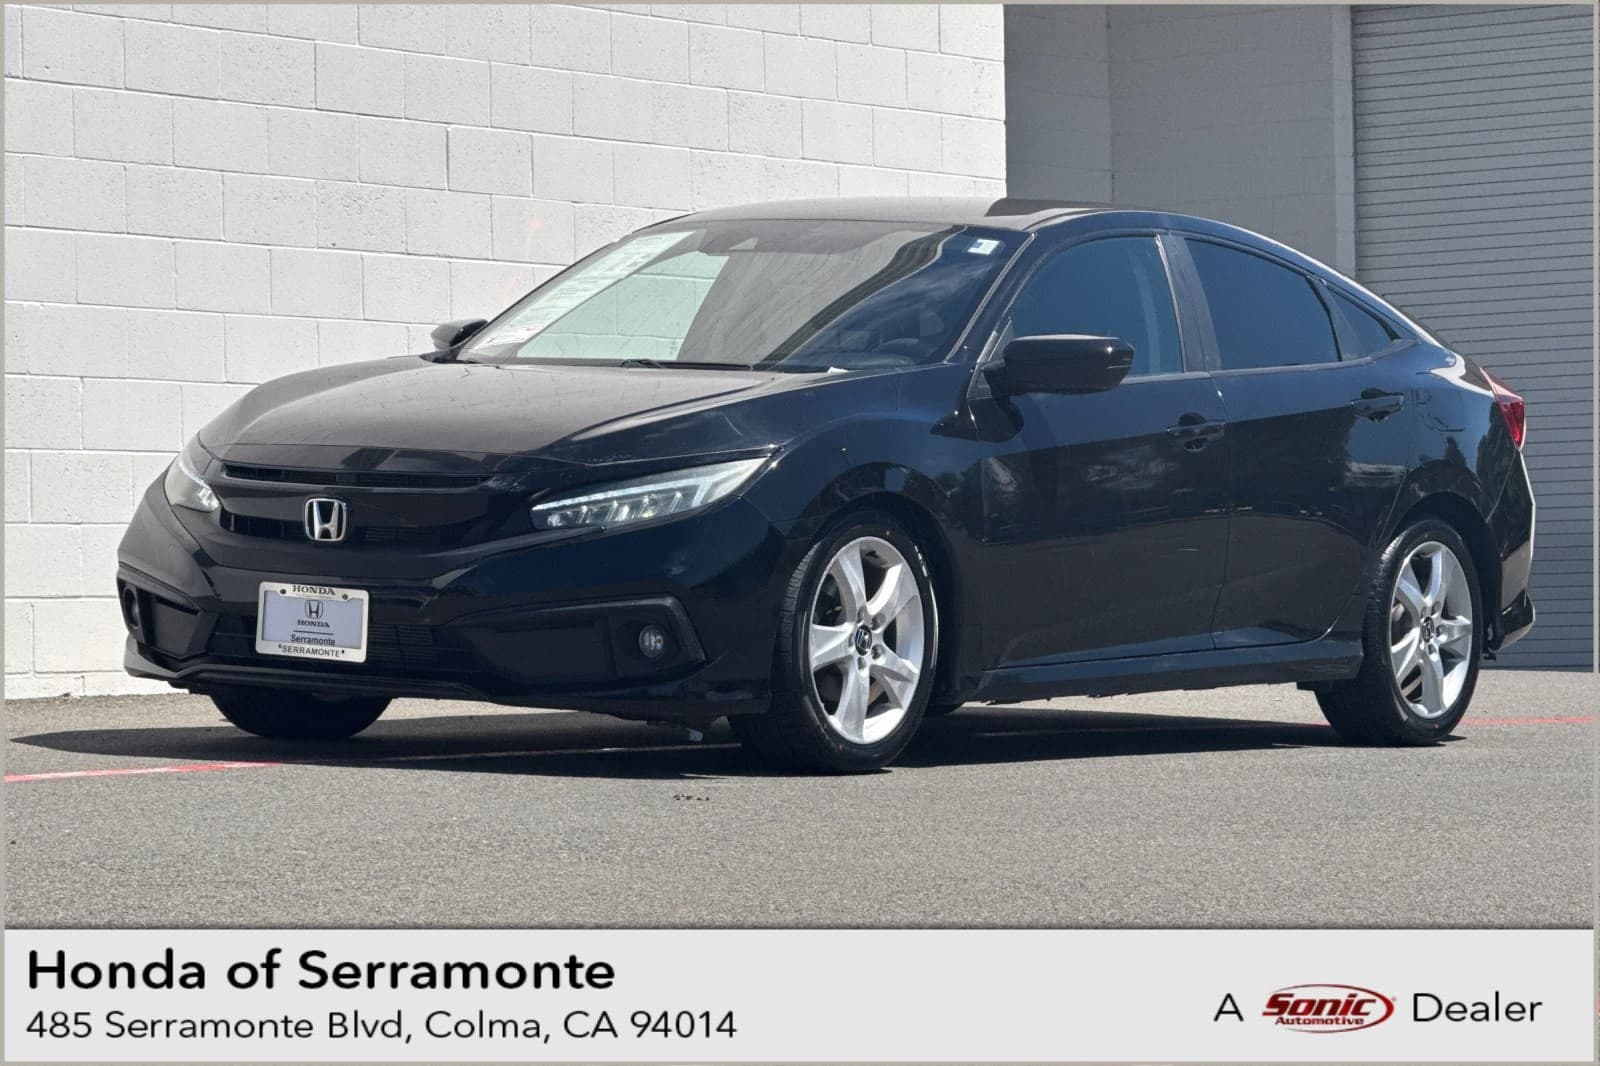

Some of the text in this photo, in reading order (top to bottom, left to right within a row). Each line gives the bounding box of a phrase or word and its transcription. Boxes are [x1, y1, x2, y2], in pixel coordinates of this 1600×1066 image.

[292, 584, 336, 596] HONDA
[297, 619, 330, 628] HONDA
[291, 633, 336, 647] Serramonte
[282, 644, 340, 657] SERRAMONTE
